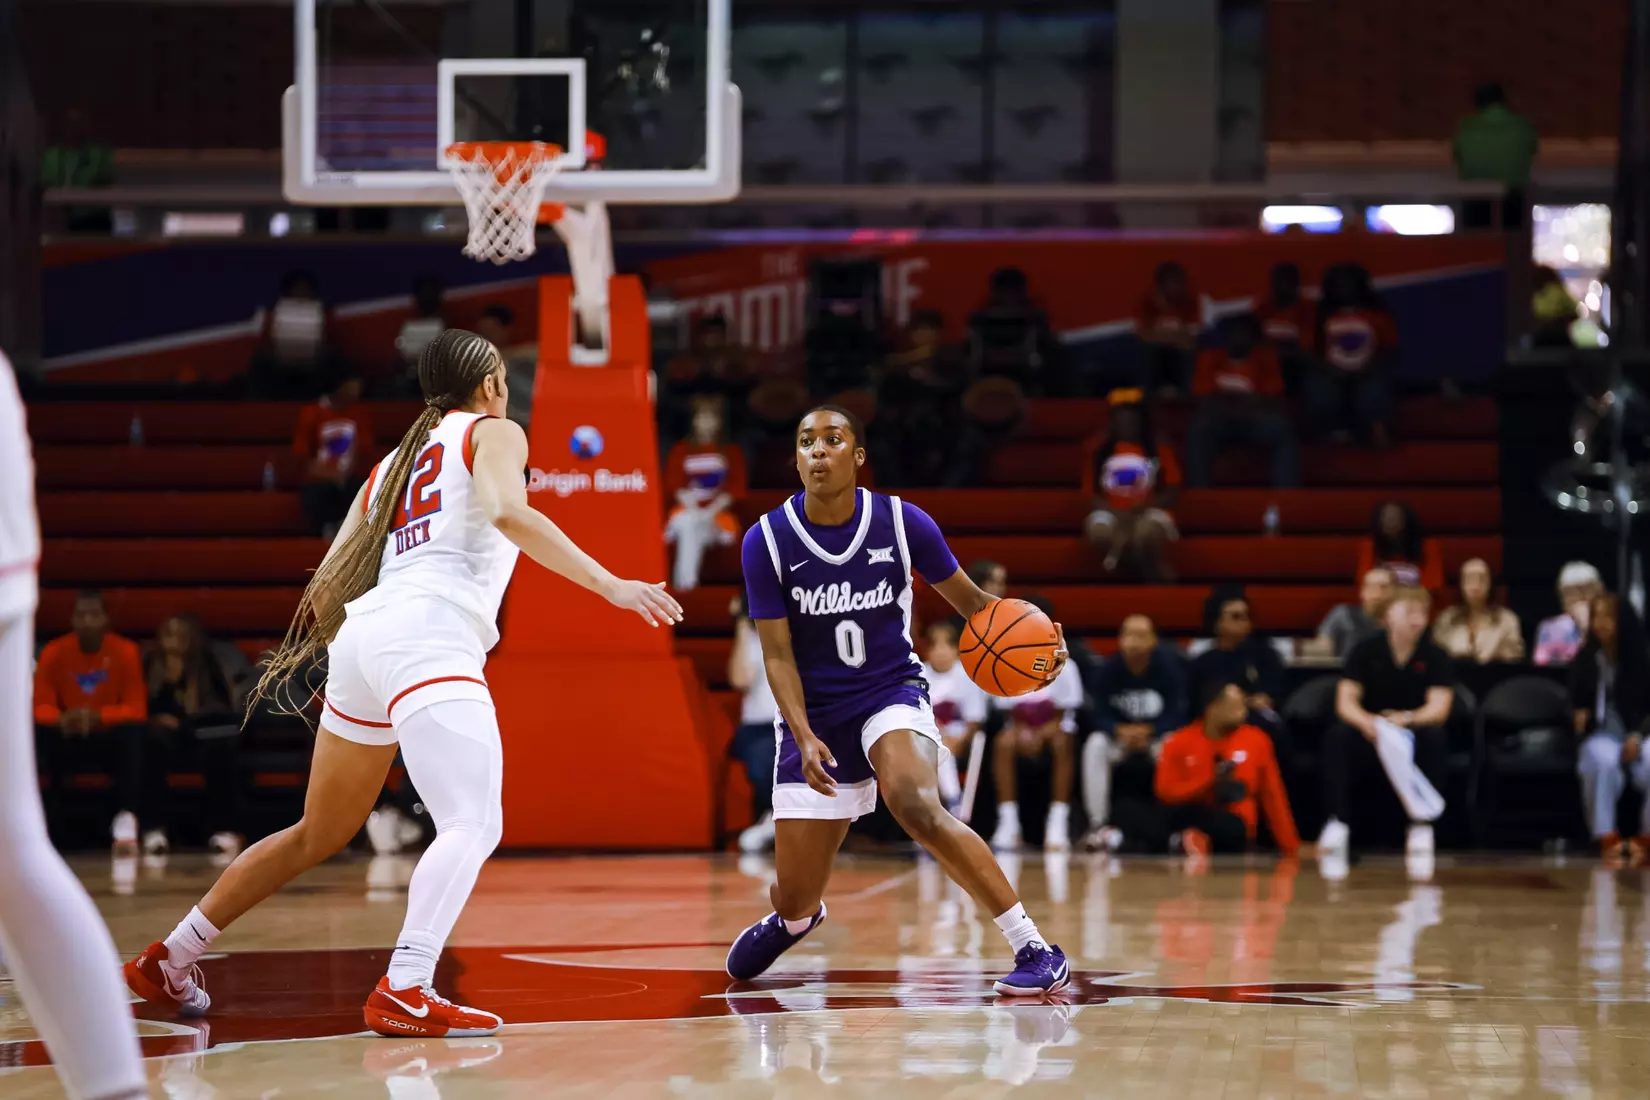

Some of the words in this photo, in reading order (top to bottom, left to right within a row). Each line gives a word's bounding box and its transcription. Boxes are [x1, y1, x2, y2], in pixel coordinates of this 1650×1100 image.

[527, 468, 592, 498] Origin
[594, 468, 647, 492] Bank
[395, 519, 431, 556] DECK
[791, 577, 894, 616] Wildcats
[835, 620, 867, 669] 0
